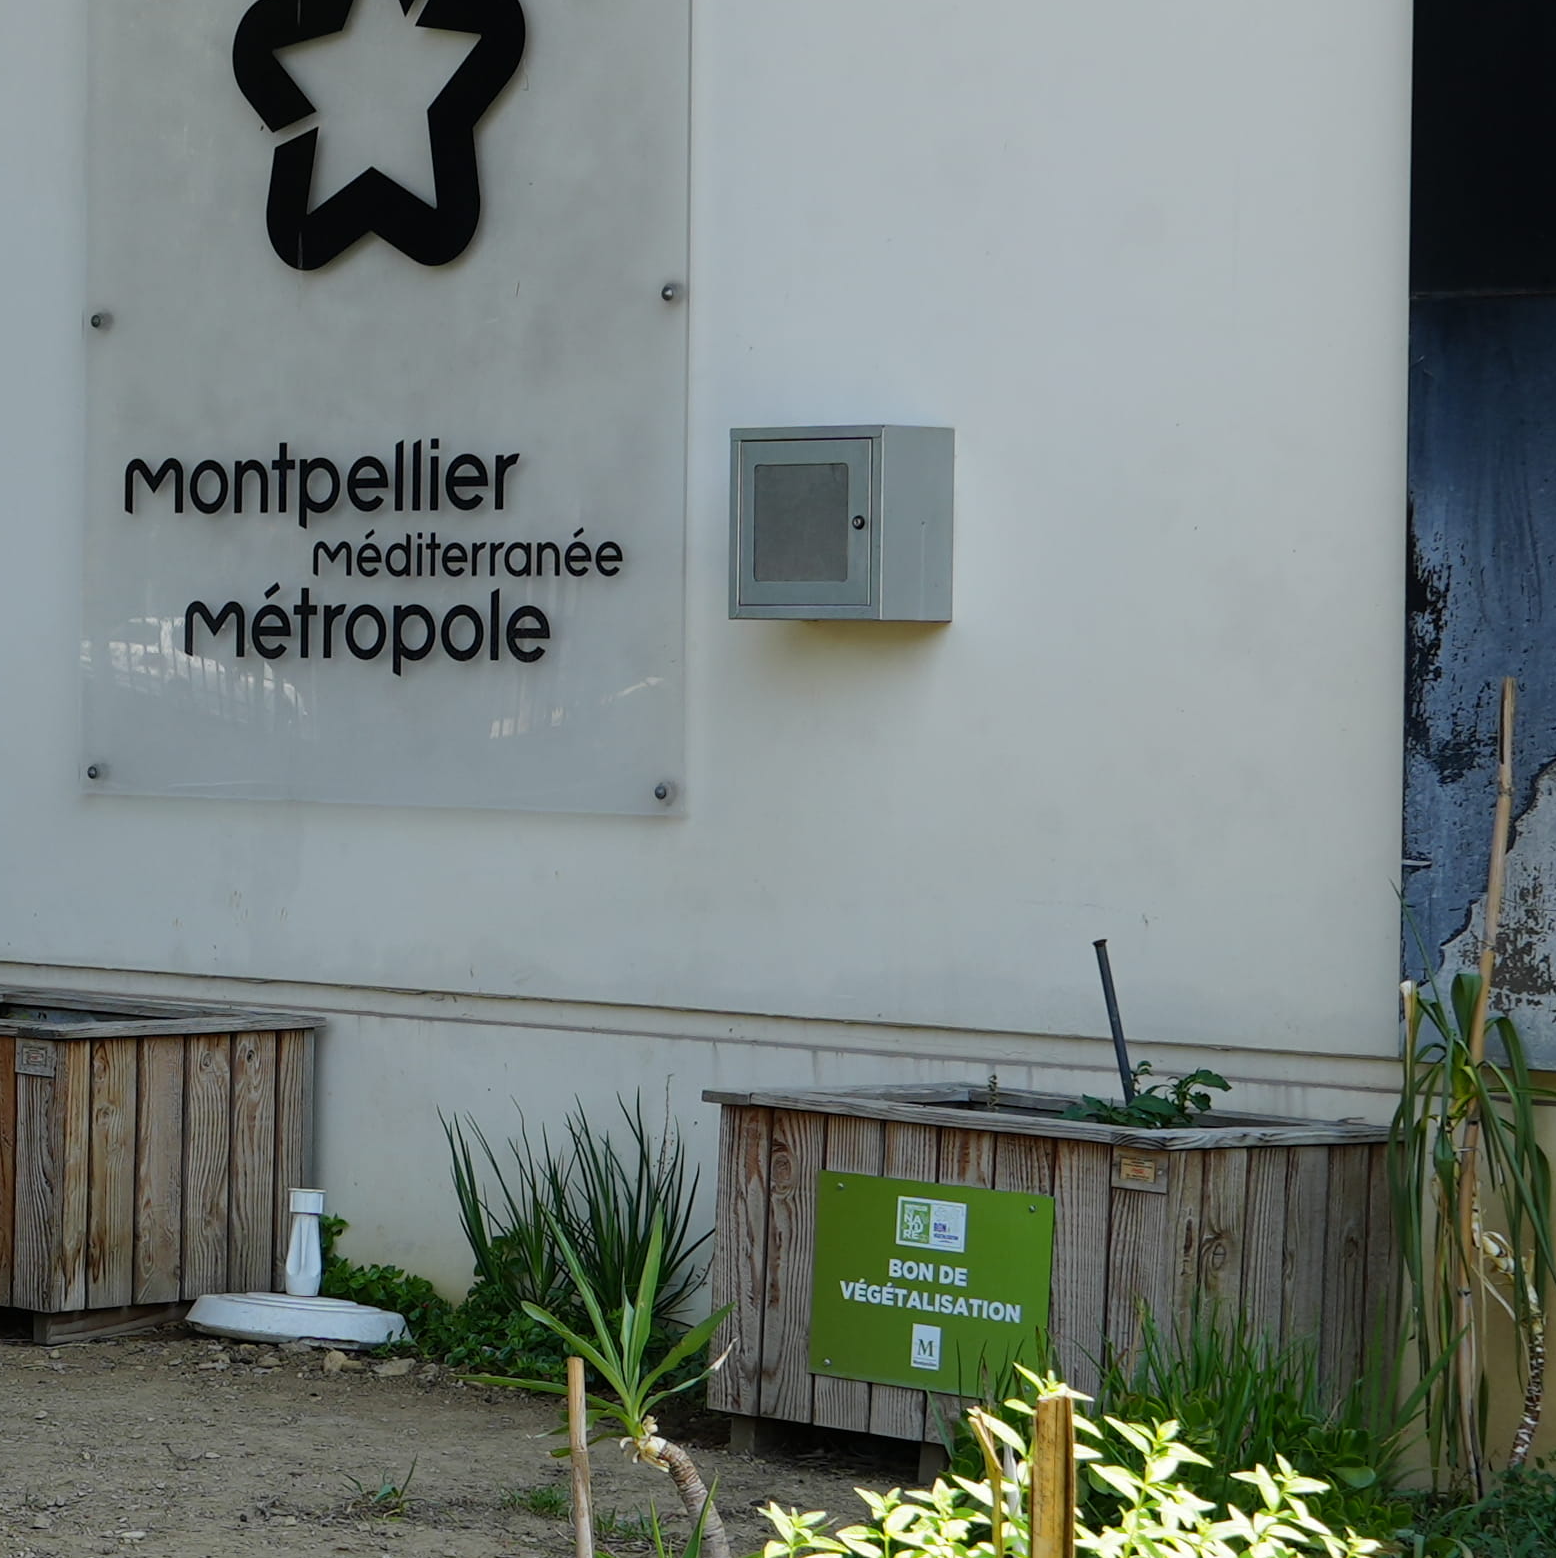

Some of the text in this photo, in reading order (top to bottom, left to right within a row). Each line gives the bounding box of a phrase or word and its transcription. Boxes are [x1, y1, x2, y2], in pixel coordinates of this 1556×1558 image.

[124, 438, 520, 529] Montpellier
[312, 527, 624, 578] Méditerranée
[185, 582, 551, 677] Métropole
[888, 1258, 968, 1287] BON DE
[840, 1278, 1021, 1324] VÉGÉTALISATION
